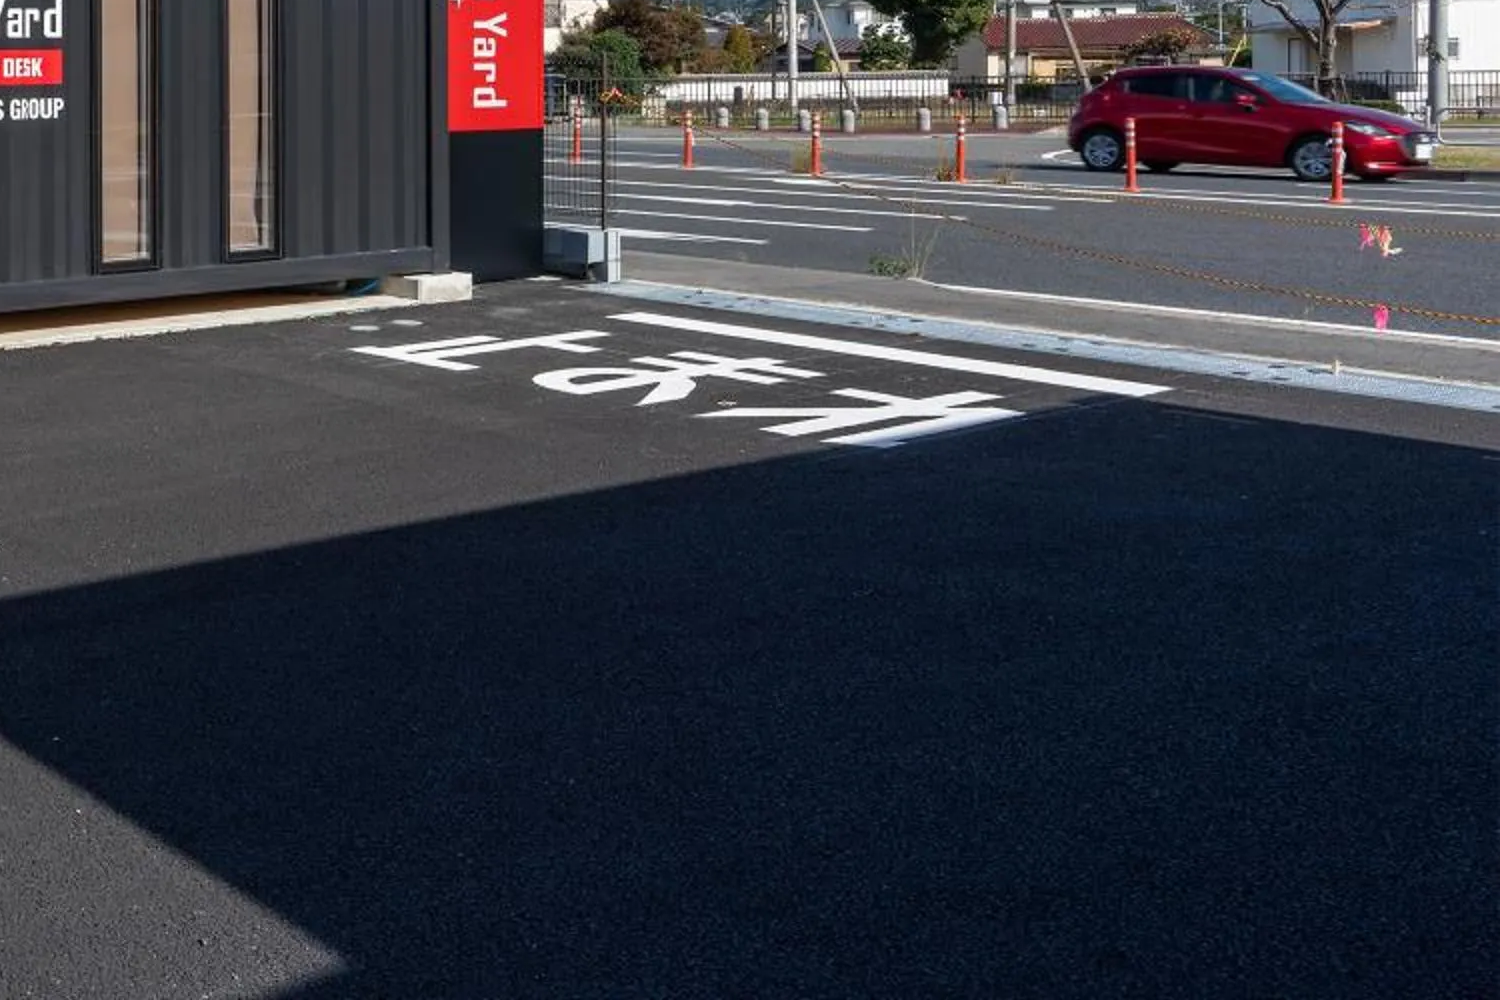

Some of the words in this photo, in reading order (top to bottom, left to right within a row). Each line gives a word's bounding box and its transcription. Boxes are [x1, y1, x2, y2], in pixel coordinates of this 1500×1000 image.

[3, 57, 43, 78] DESK
[472, 12, 507, 108] Yard
[9, 97, 65, 121] GROUP
[349, 329, 1028, 449] 止まれ
